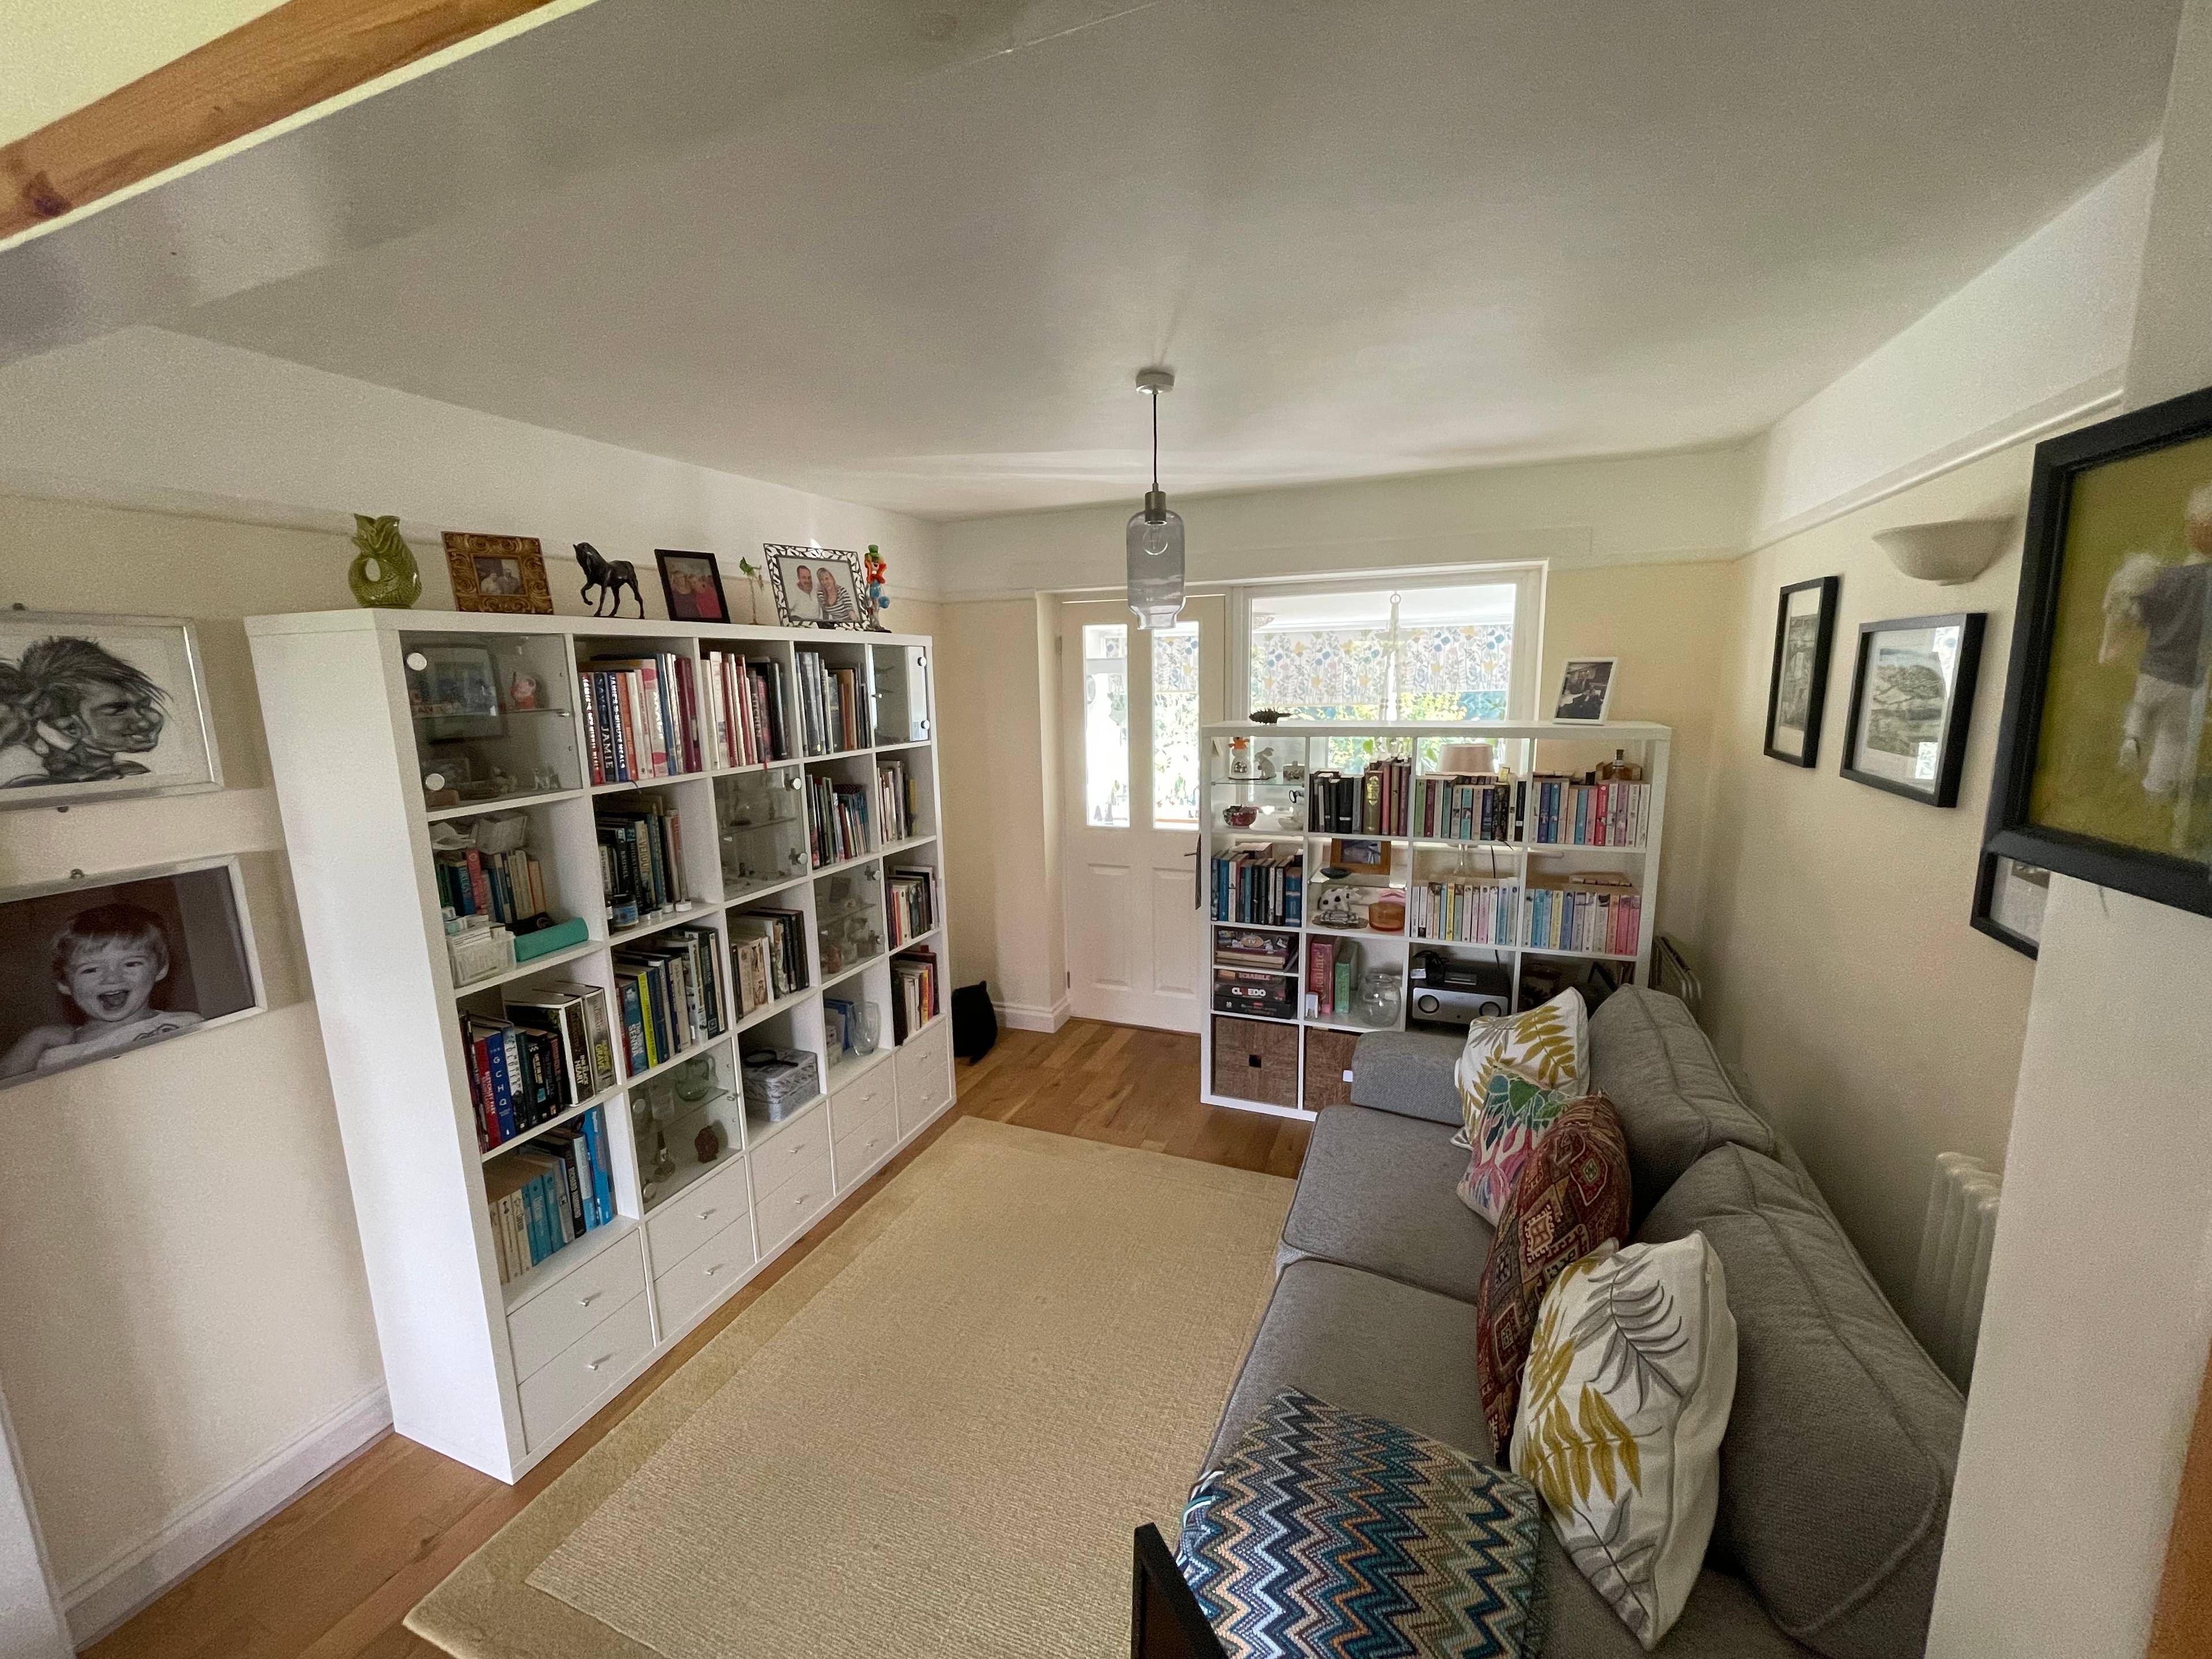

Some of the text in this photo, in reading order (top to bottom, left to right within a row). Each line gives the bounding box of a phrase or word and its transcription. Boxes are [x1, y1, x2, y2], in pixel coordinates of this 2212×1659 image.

[751, 693, 762, 738] KITCHEN
[601, 726, 613, 769] JAMIE
[628, 1024, 639, 1056] SENNA
[595, 1044, 604, 1070] GRAVE
[569, 1167, 578, 1191] RICHARD
